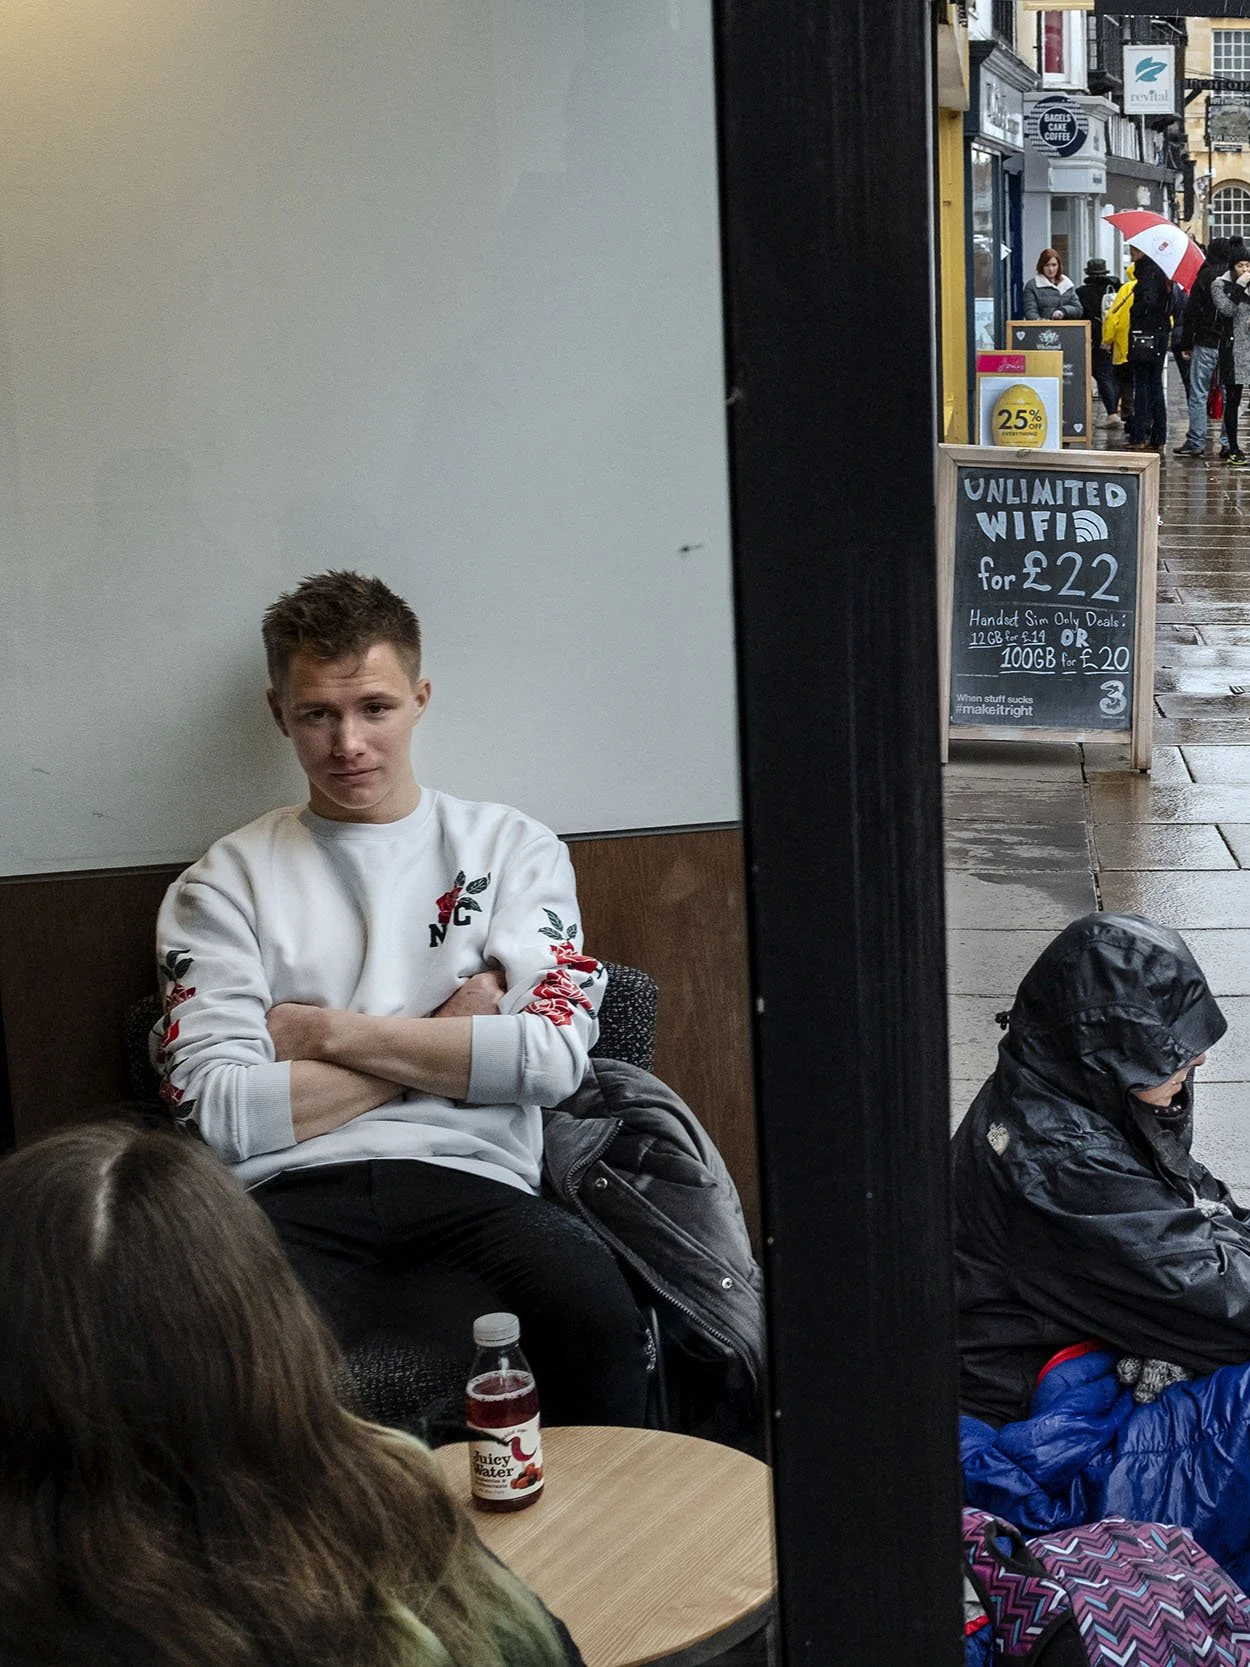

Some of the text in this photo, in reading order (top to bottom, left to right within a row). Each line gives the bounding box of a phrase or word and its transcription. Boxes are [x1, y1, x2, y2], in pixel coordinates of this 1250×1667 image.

[1130, 89, 1169, 102] revital
[1044, 113, 1072, 123] BAGELS
[1048, 122, 1068, 132] CAKE
[1044, 132, 1071, 141] COFFEE
[998, 409, 1042, 430] 25%
[964, 477, 1127, 508] UNLIMITED
[976, 511, 1067, 542] WIFI
[978, 550, 1120, 602] for £22
[969, 609, 1126, 634] Handset Sim Only Deals:
[1005, 630, 1018, 642] for
[1060, 628, 1089, 648] OR
[1000, 646, 1130, 671] 100GB for £20
[956, 693, 1034, 704] When stuff sucks
[955, 703, 1034, 718] #makeitright
[472, 1450, 511, 1468] Juicy
[471, 1461, 514, 1478] Water
